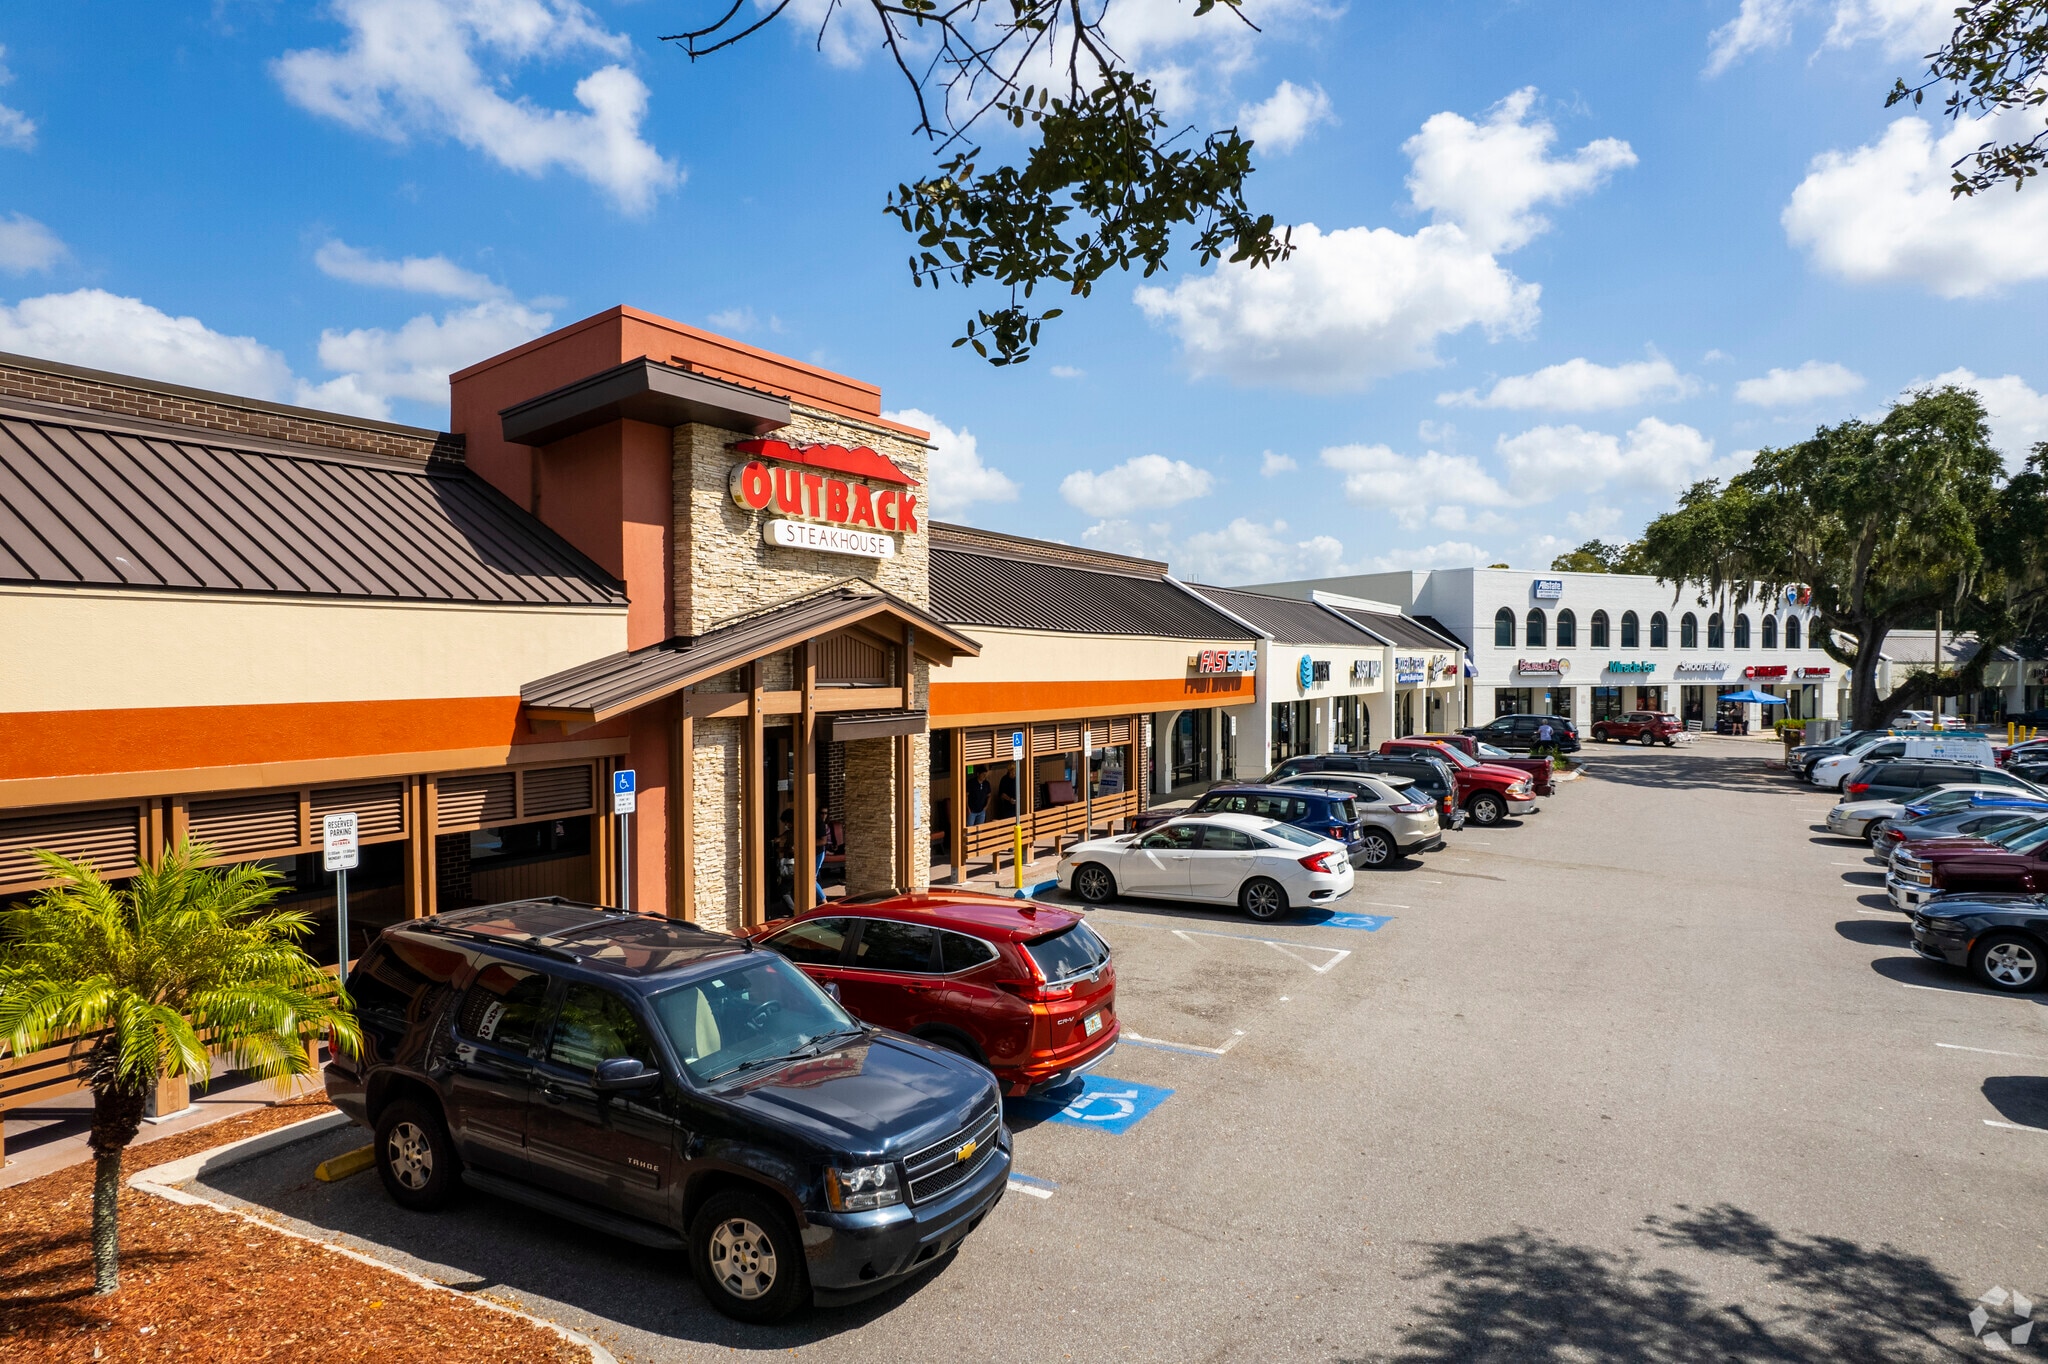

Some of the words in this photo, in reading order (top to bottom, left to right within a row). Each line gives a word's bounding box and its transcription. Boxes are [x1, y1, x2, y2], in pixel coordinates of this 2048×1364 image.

[741, 461, 918, 534] OUTBACK
[786, 524, 885, 554] STEAKHOUSE
[1538, 581, 1561, 590] Allstate
[1199, 649, 1257, 673] FASTSIGNS
[1609, 661, 1656, 673] Miracle-Ear
[1680, 661, 1714, 671] SMOOTHIE
[1312, 661, 1331, 681] AT&T
[328, 820, 353, 828] RESERVED
[330, 828, 352, 837] PARKING
[628, 1158, 659, 1171] TAHOE
